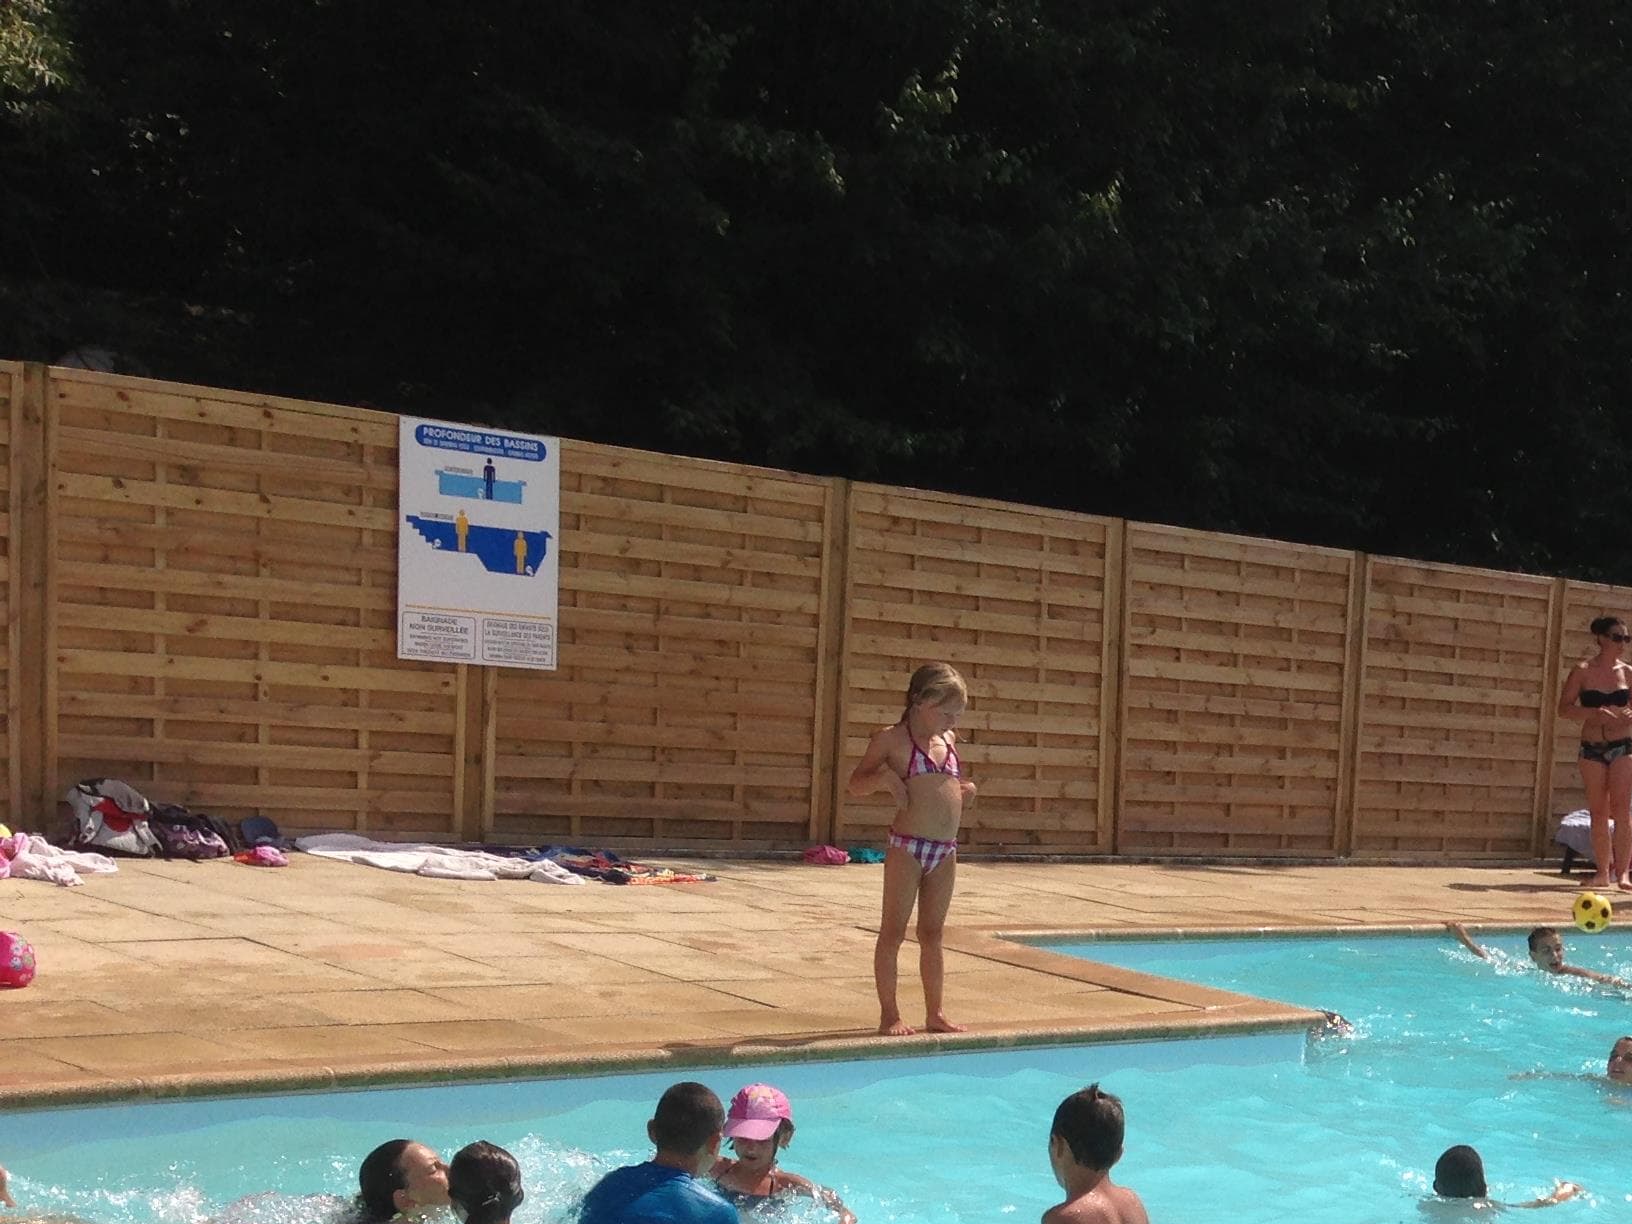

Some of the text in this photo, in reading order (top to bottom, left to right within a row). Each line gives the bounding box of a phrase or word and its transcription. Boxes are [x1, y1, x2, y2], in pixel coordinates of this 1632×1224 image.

[423, 426, 482, 443] PROFONDEUR
[485, 436, 501, 446] DES
[504, 438, 539, 451] BASSINS
